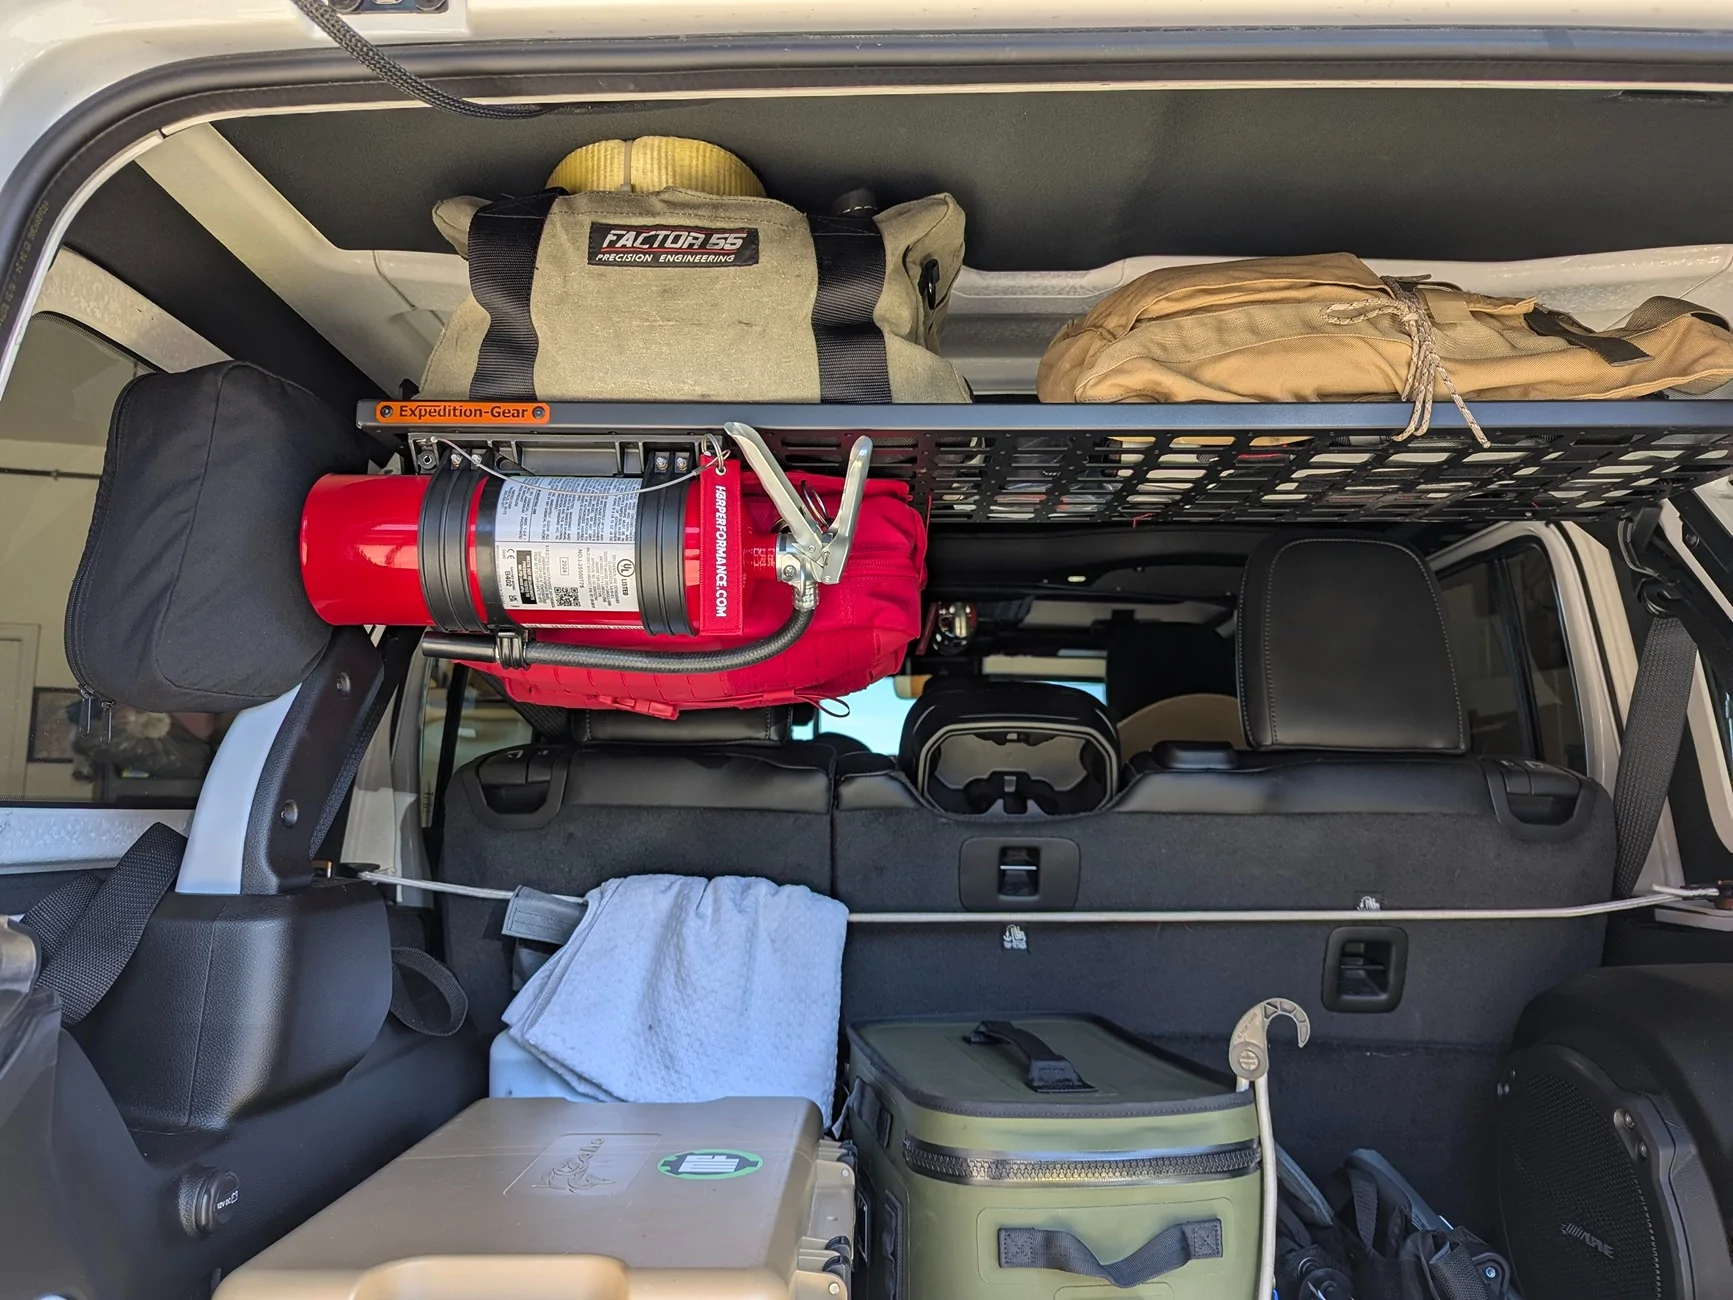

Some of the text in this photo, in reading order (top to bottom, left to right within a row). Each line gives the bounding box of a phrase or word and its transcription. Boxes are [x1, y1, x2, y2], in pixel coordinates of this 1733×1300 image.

[601, 230, 748, 250] FACTOR 55
[595, 253, 736, 263] PRECISION ENGINEERING
[398, 405, 528, 421] Expedition-Gear
